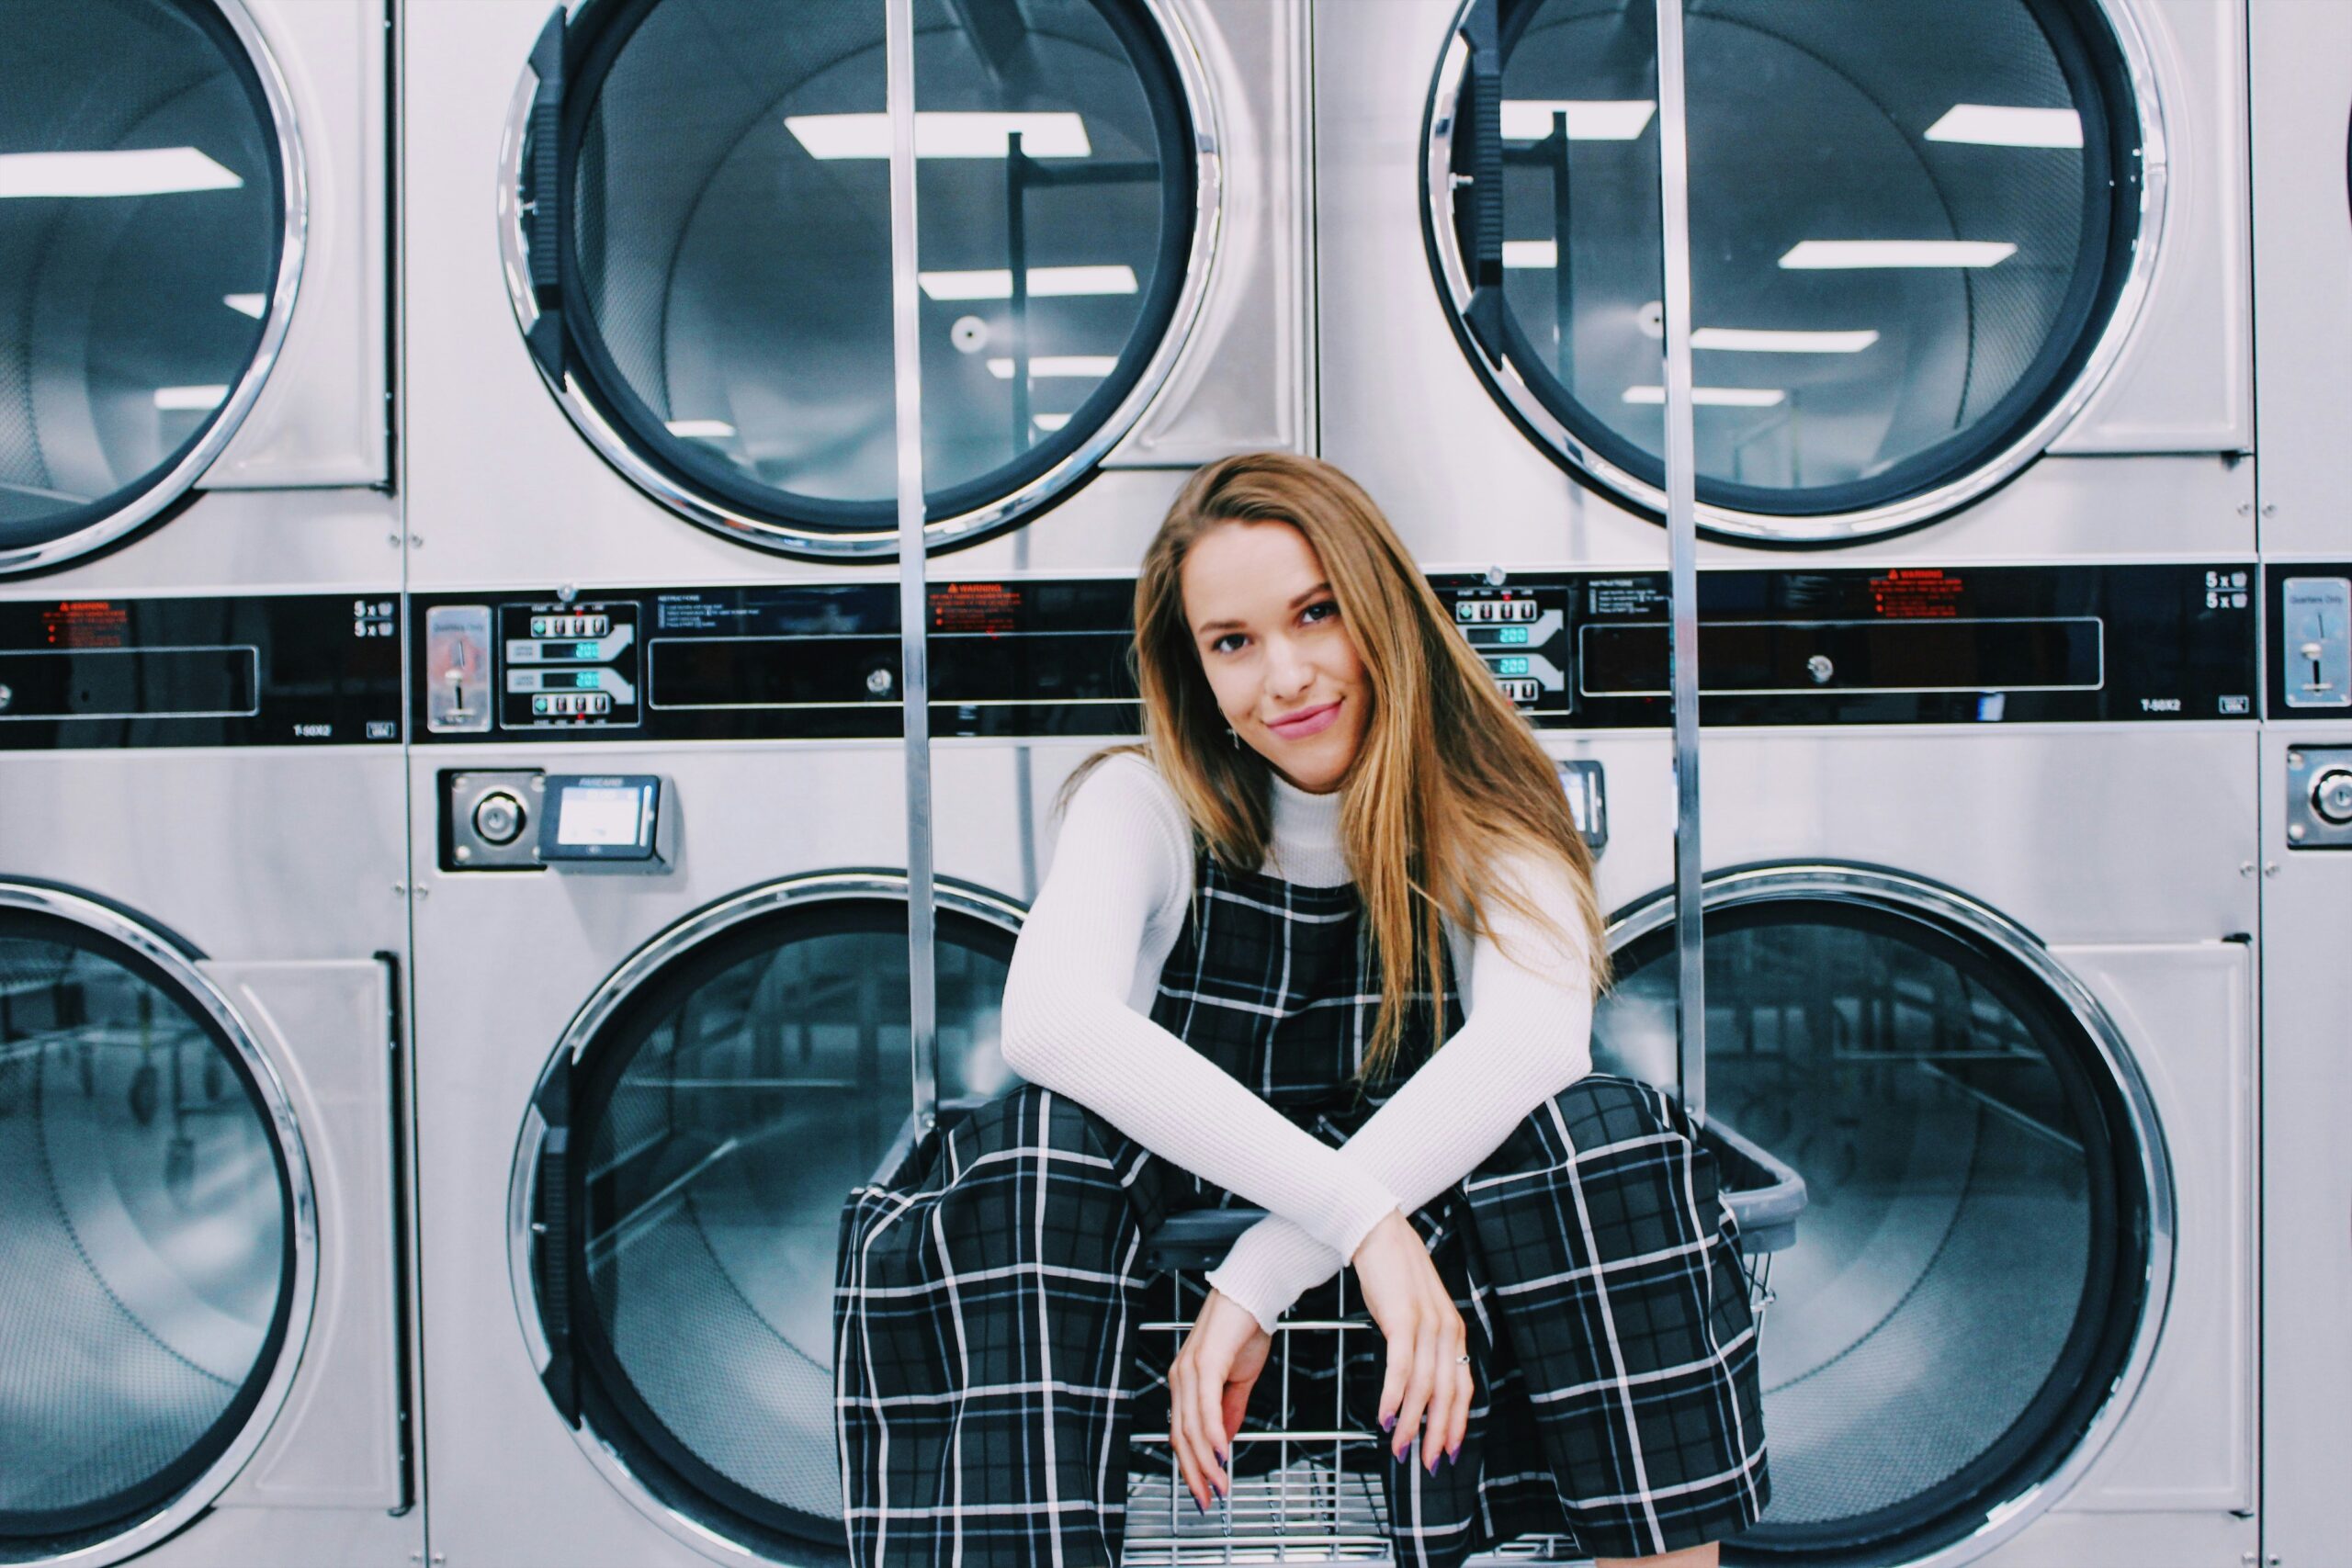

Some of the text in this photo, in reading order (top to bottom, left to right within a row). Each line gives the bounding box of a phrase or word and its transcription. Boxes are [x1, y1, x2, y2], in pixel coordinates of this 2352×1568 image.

[958, 583, 1003, 592] WARNING
[2206, 570, 2218, 588] 5
[354, 600, 366, 617] 5
[2206, 592, 2219, 609] 5
[355, 619, 367, 637] 5
[1499, 627, 1528, 643] 200
[1499, 658, 1528, 674] 200
